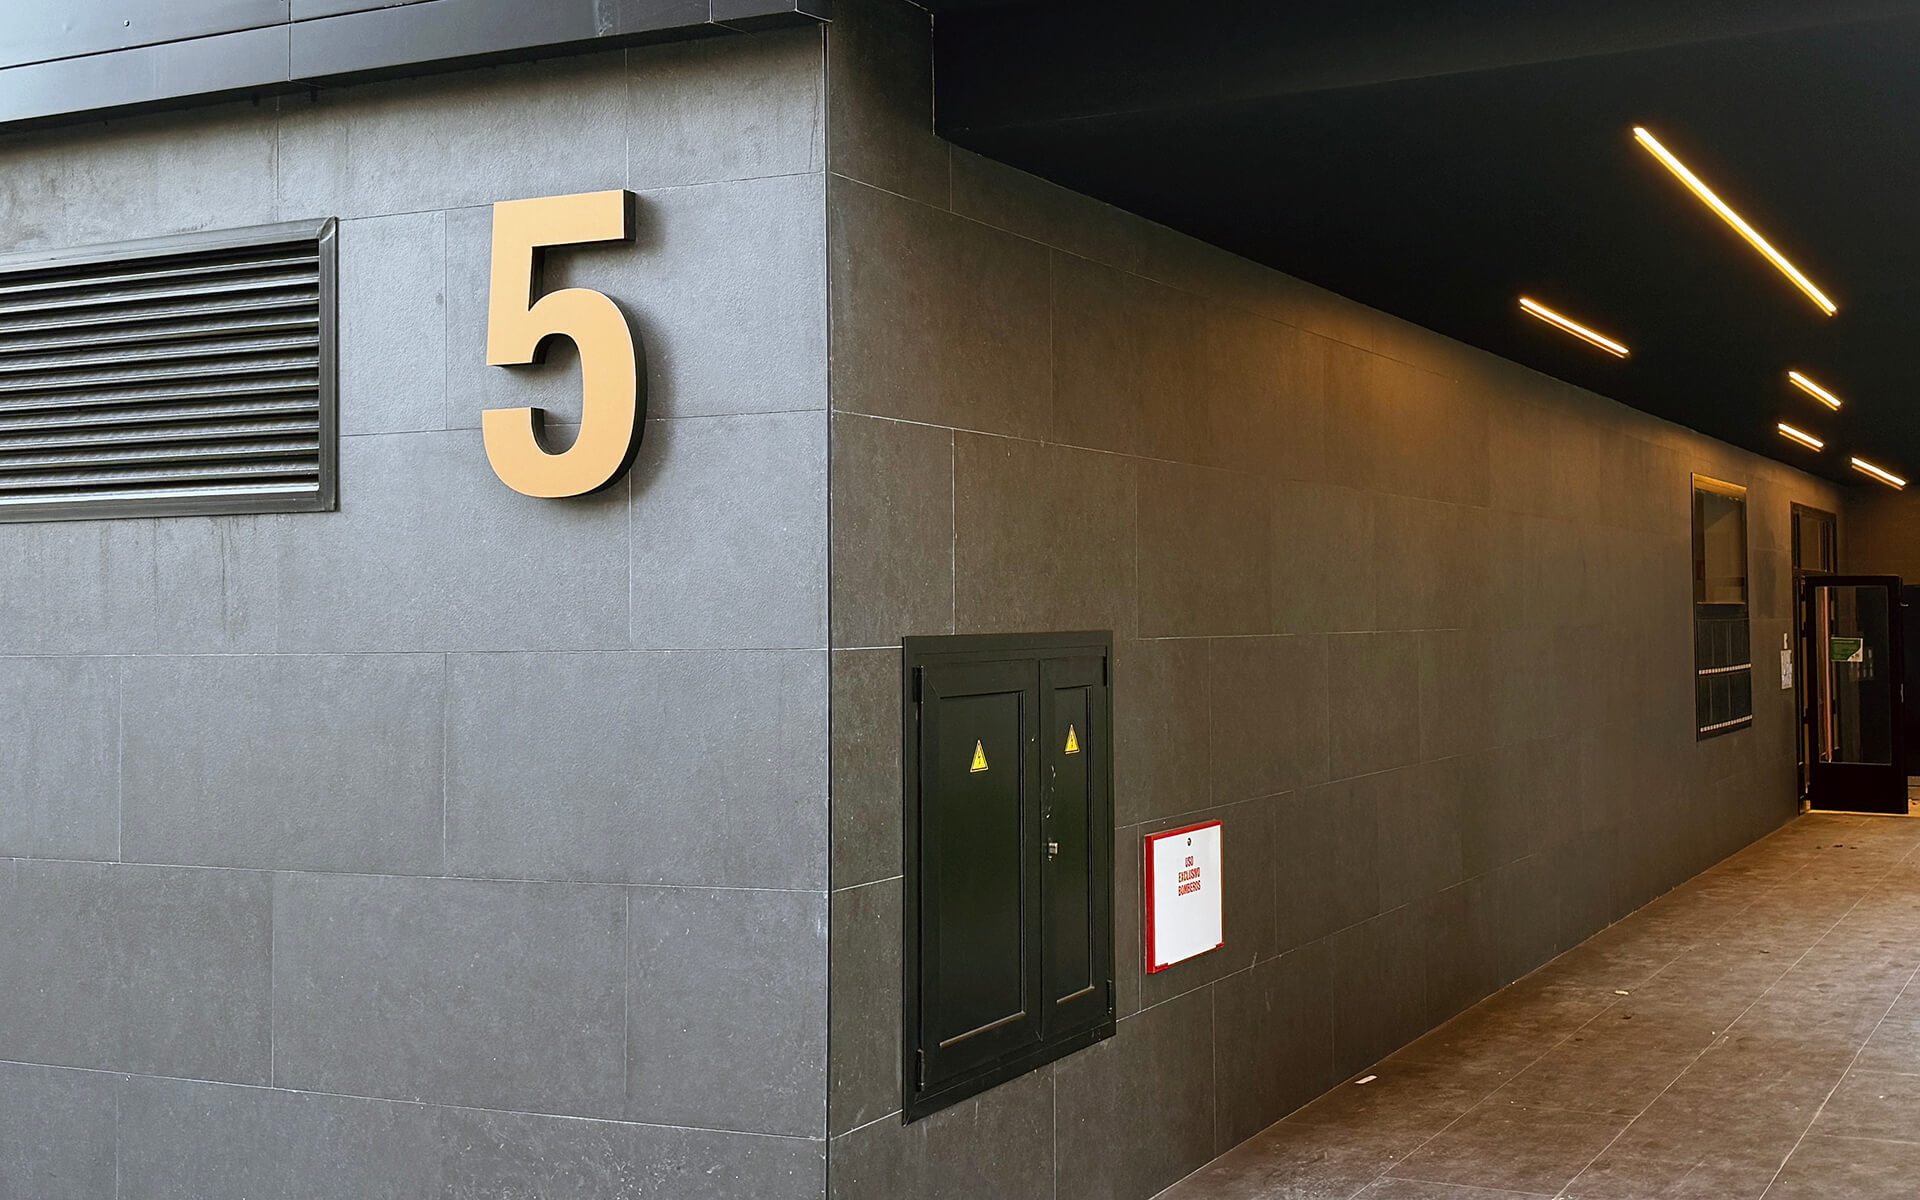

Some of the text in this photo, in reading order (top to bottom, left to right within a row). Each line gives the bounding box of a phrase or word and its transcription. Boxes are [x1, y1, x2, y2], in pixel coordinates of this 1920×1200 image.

[482, 189, 645, 499] 5
[1185, 855, 1194, 868] USO
[1178, 867, 1200, 883] EXCLUSIVO
[1178, 880, 1201, 896] BOMBEROS
